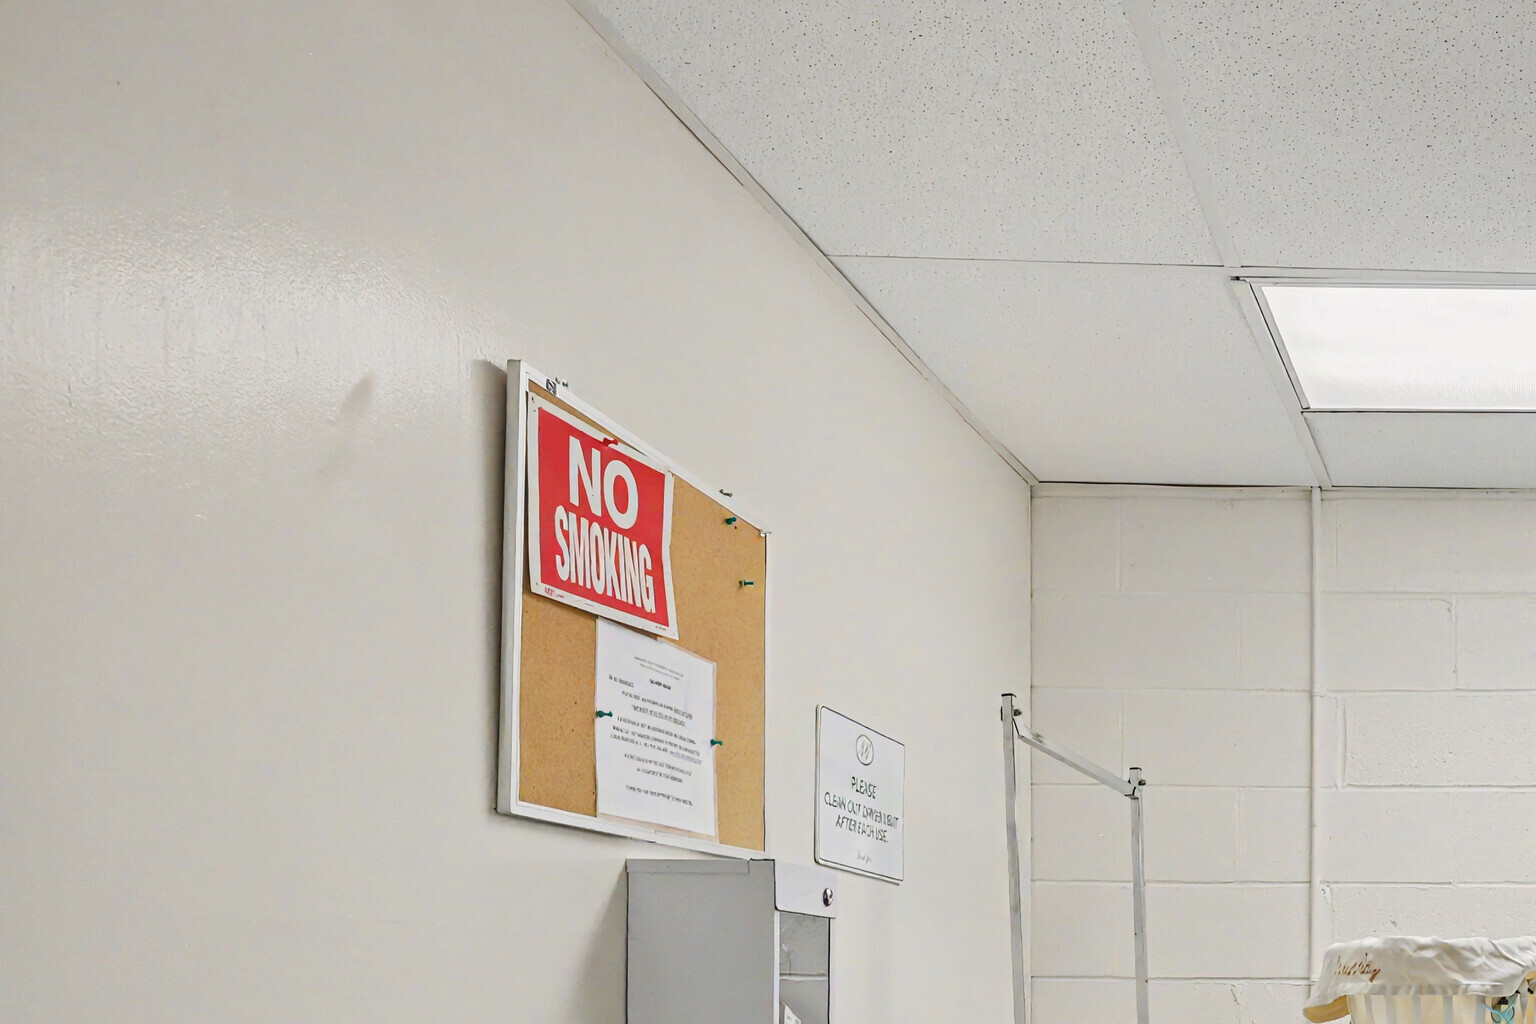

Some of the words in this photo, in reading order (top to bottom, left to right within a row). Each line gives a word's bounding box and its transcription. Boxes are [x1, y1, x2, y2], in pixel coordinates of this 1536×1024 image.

[569, 435, 639, 530] NO
[554, 504, 656, 614] SMOKING
[851, 776, 877, 799] PLEASE
[824, 791, 847, 811] CLEAN
[847, 799, 861, 815] OUT
[836, 814, 857, 832] AFTER
[857, 821, 875, 838] EACH
